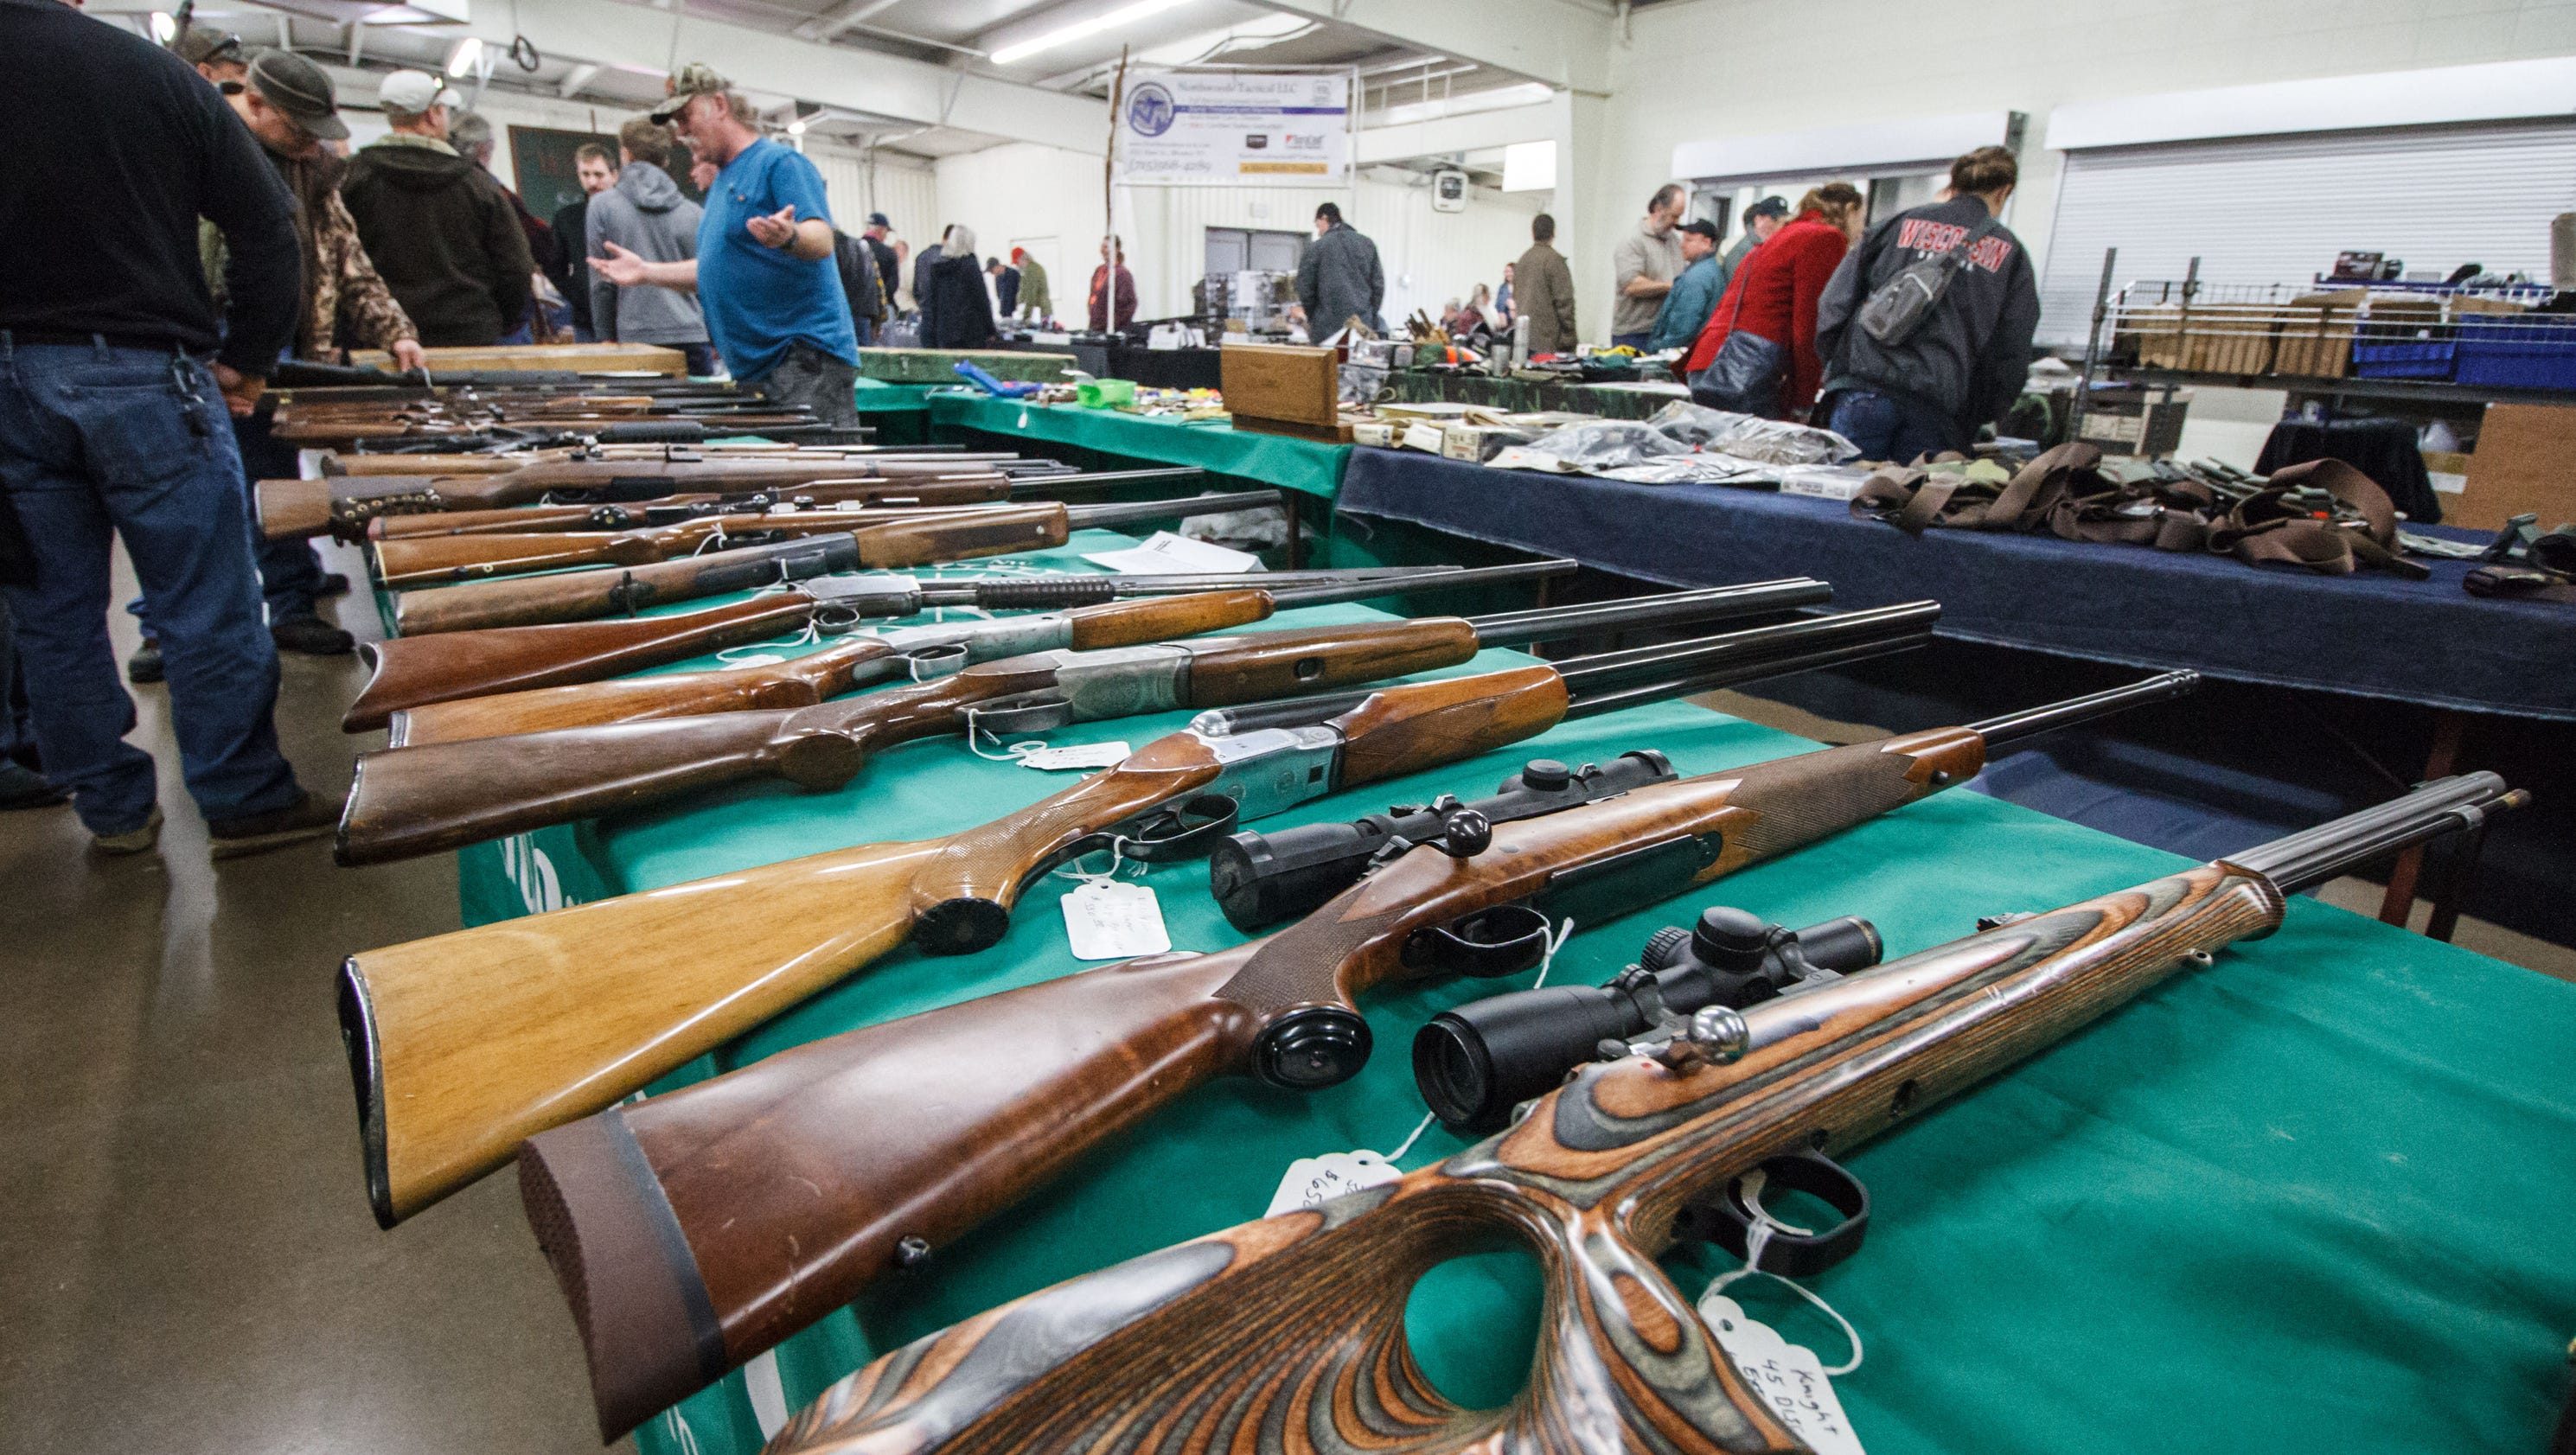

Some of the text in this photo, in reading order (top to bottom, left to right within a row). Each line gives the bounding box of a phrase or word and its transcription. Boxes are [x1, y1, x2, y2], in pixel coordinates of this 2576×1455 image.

[1237, 81, 1274, 93] Tactical
[1275, 82, 1298, 93] LLC
[1896, 219, 2012, 273] WISCOSIN
[1761, 1359, 1786, 1388] 45
